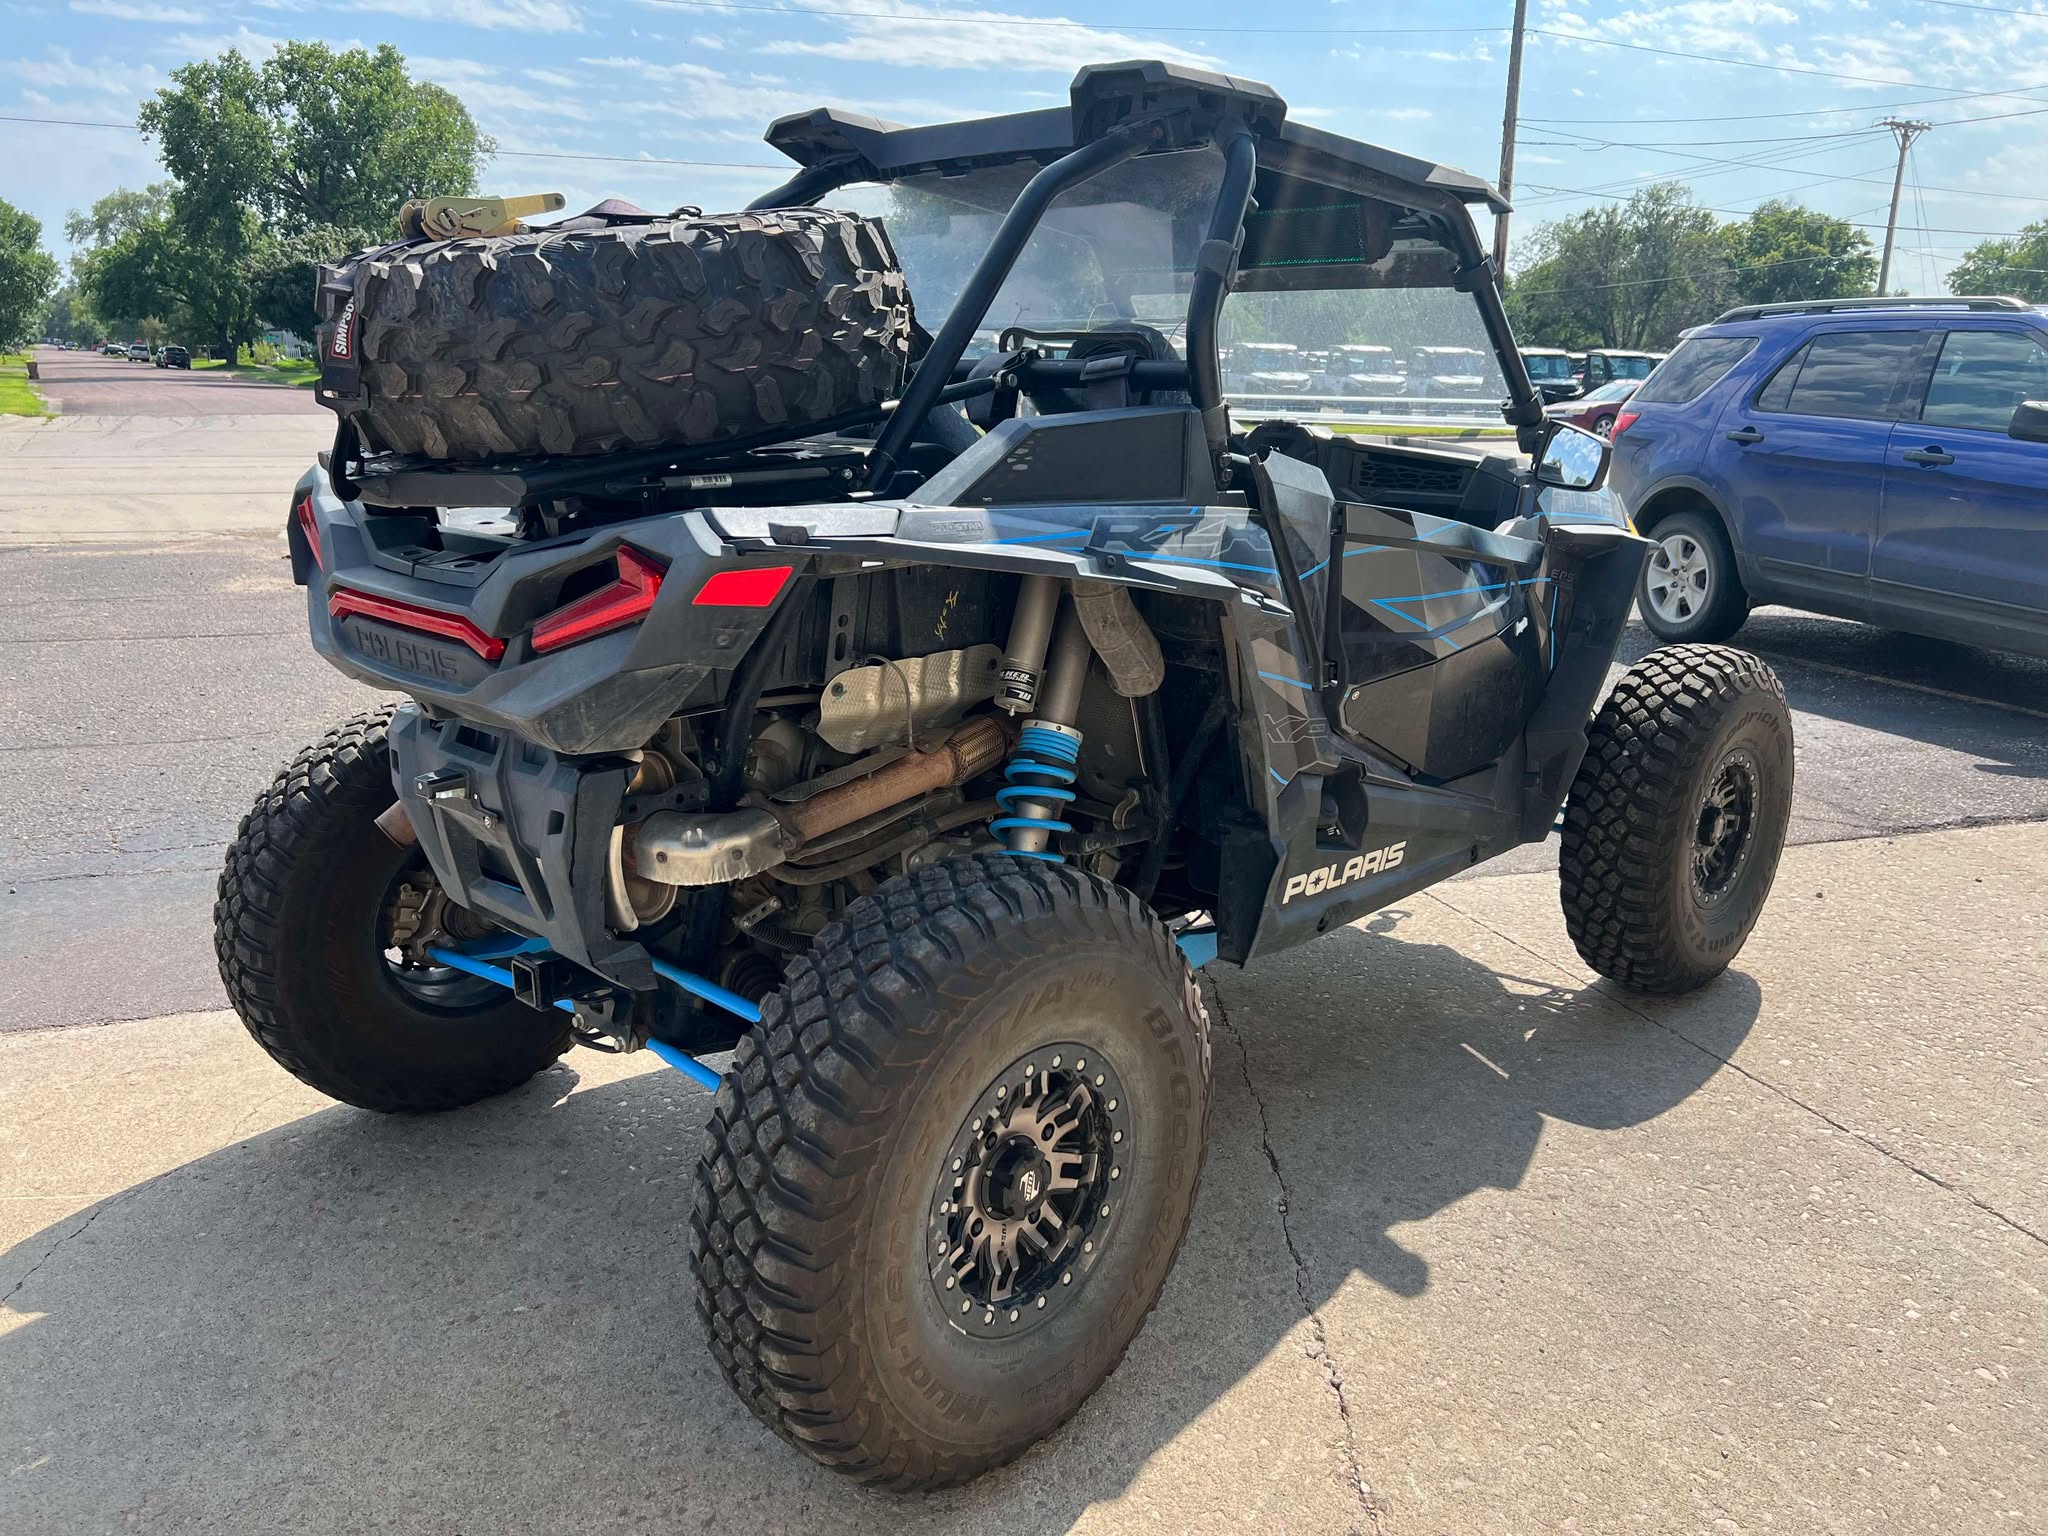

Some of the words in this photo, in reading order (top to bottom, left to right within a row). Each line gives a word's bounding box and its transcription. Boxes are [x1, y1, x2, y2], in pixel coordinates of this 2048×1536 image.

[1551, 568, 1576, 583] EPS
[355, 625, 457, 677] POLARIS
[1282, 840, 1407, 905] POLARIS
[1025, 1169, 1034, 1201] TUSK
